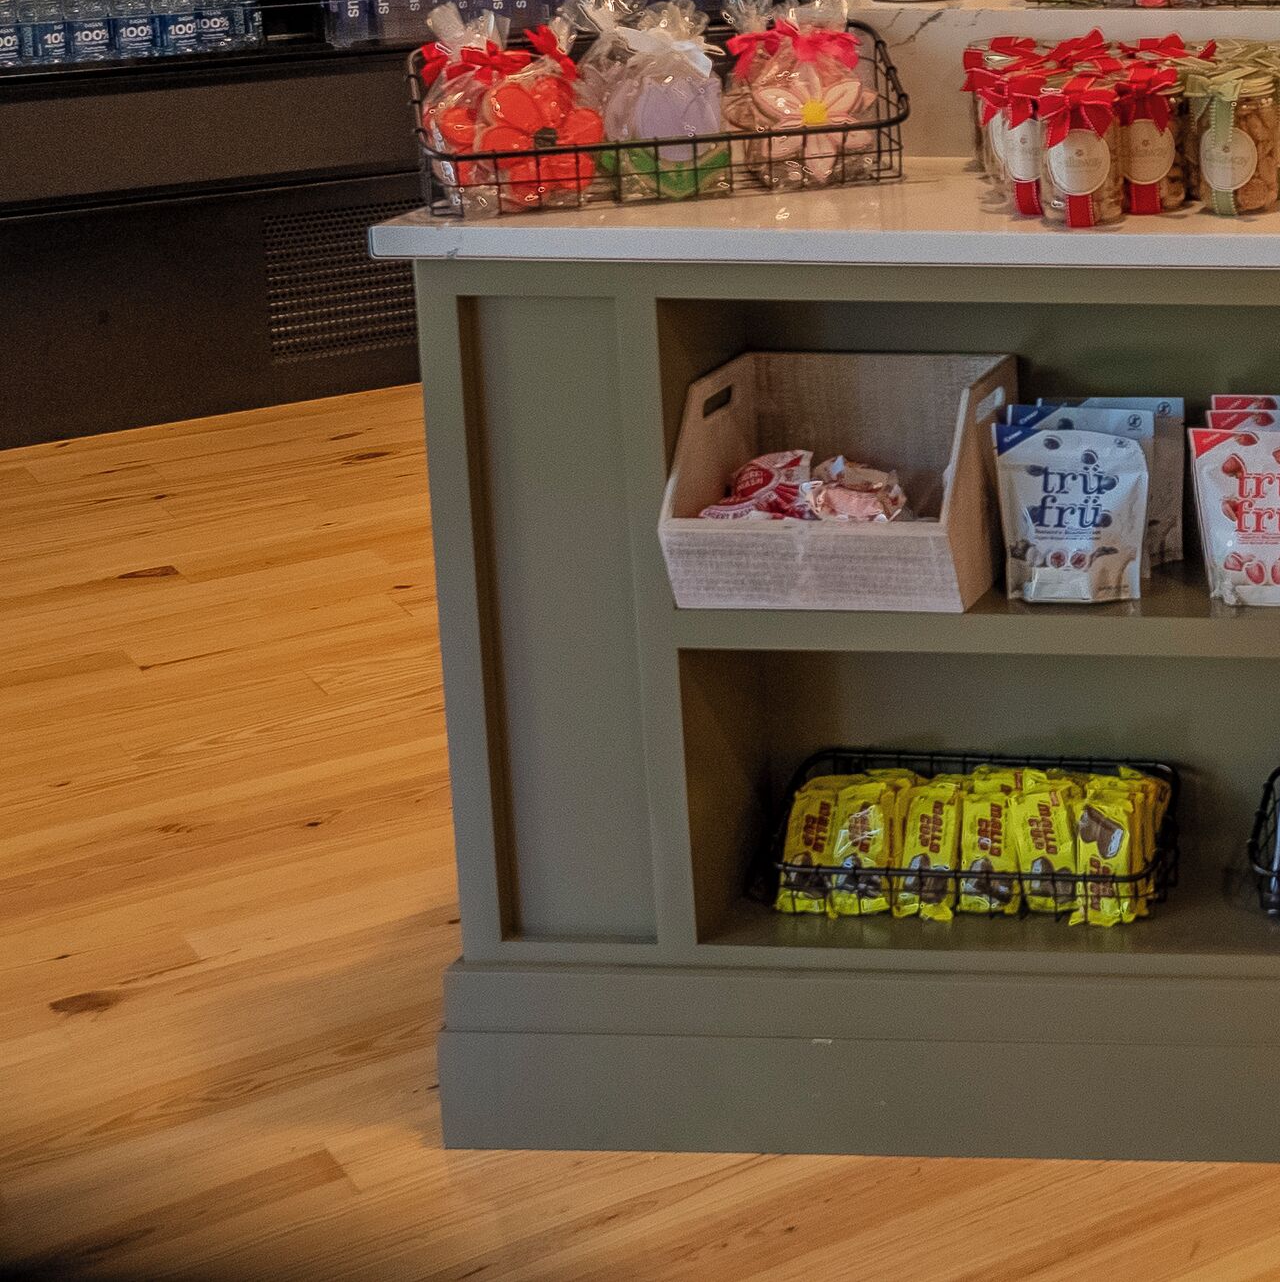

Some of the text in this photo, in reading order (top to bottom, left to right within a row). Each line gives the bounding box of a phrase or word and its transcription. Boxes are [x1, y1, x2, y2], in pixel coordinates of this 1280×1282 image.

[1042, 464, 1100, 495] trü
[1035, 496, 1100, 529] frü
[918, 814, 932, 847] CUP
[989, 802, 1003, 857] MALLO
[1028, 817, 1046, 851] CUP
[1038, 803, 1058, 855] MALLO
